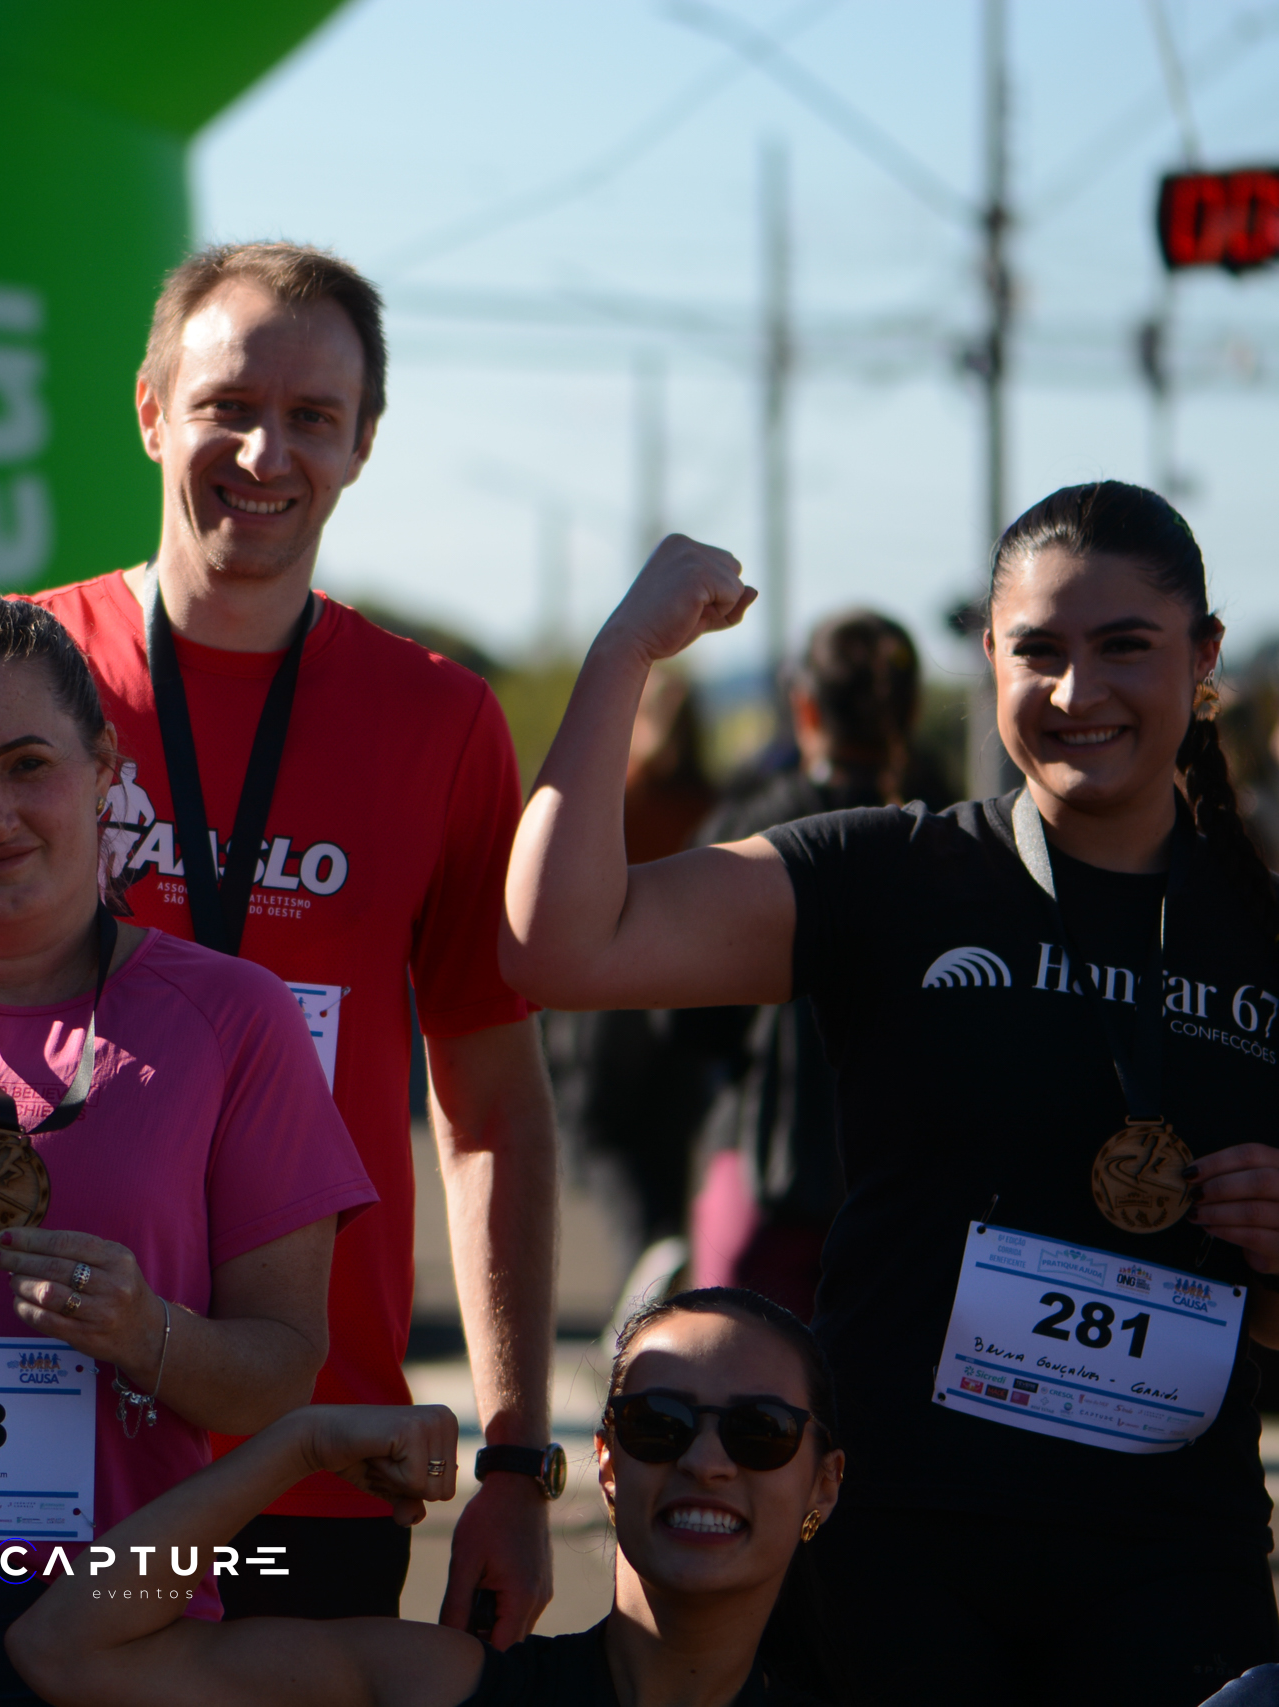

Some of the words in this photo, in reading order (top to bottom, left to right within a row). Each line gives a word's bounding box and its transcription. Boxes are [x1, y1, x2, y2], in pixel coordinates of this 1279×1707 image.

[164, 894, 184, 904] SÃO
[249, 906, 263, 915] DO
[268, 907, 302, 919] OESTE
[249, 895, 311, 909] ATLETISMO
[1171, 1021, 1277, 1065] CONFECÇÕES
[1042, 1259, 1078, 1271] PRATIQUE
[1079, 1266, 1103, 1279] AJUDA
[1116, 1273, 1137, 1287] ONG
[1172, 1295, 1208, 1312] CAUSA
[1031, 1291, 1151, 1359] 281
[19, 1373, 59, 1384] CAUSA
[976, 1369, 1006, 1384] Sicredi
[1049, 1389, 1074, 1400] CRESOL
